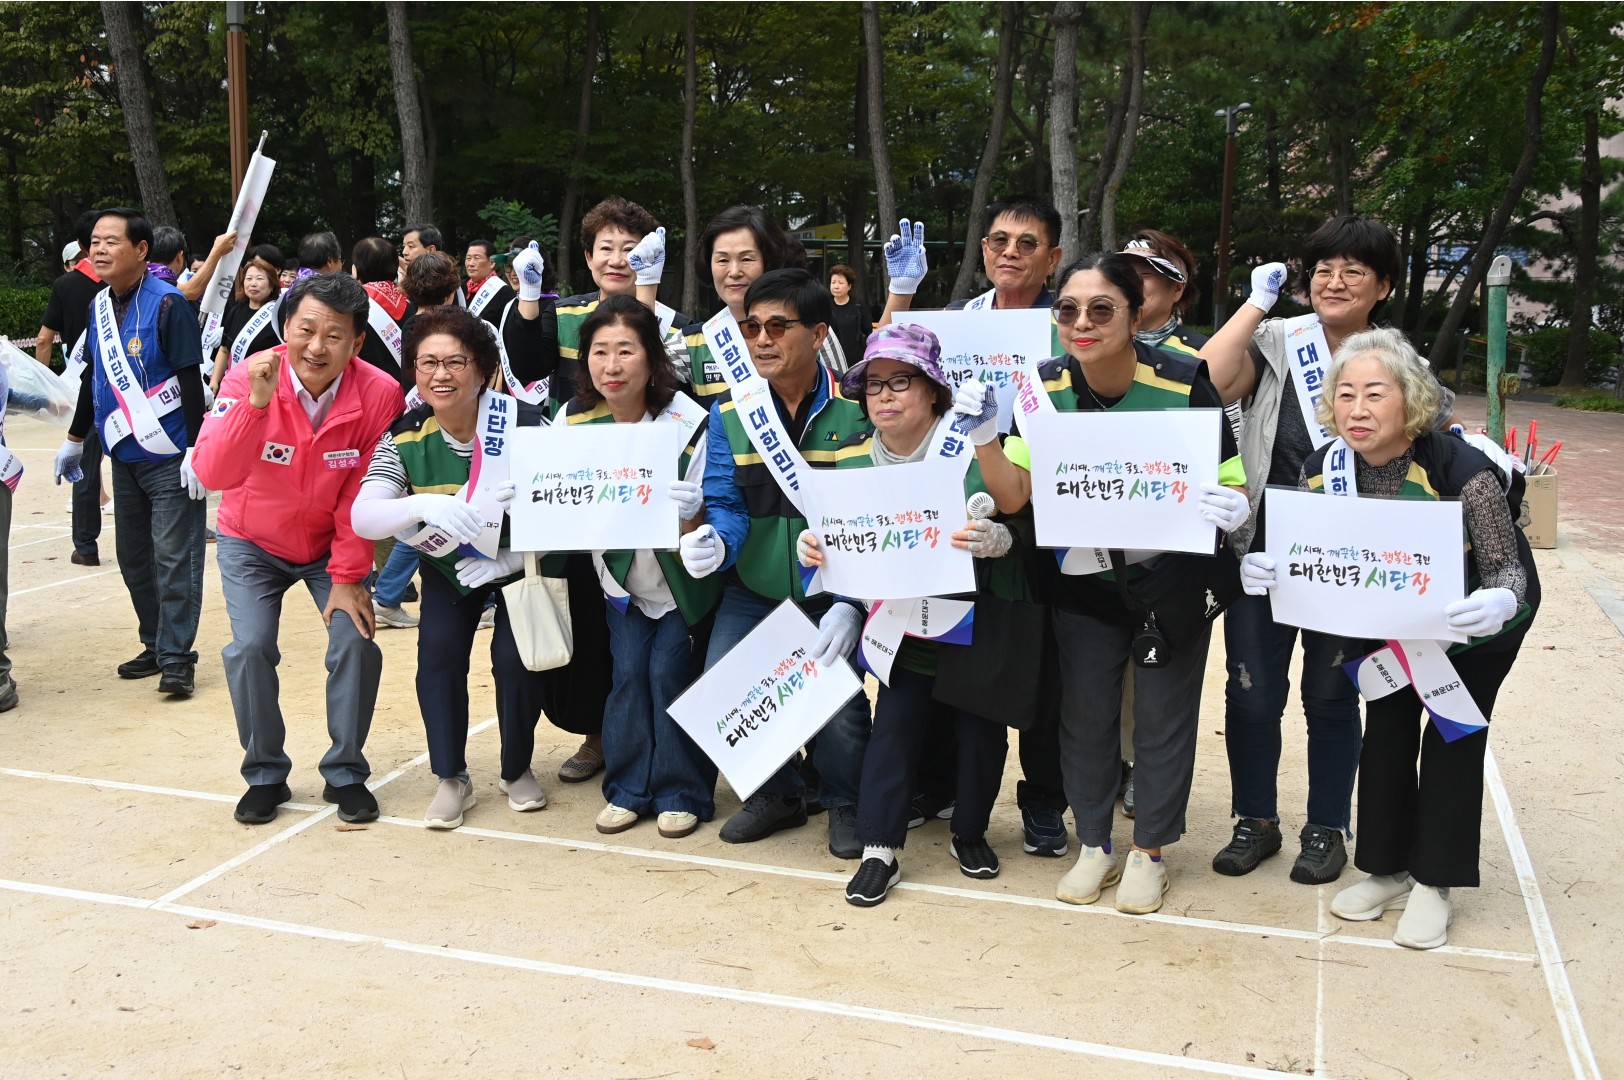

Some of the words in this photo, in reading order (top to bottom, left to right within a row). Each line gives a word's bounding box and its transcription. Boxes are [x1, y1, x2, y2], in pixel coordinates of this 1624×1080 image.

[107, 345, 131, 392] 새단장
[1012, 354, 1026, 365] 국민
[979, 369, 1025, 390] 새단장
[484, 397, 507, 457] 새단장
[328, 458, 358, 469] 김성수
[1056, 462, 1068, 475] 새
[1143, 461, 1171, 475] 행복한
[1172, 462, 1188, 475] 국민
[532, 472, 543, 484] 새
[612, 467, 638, 480] 행복한
[639, 468, 653, 479] 국민
[532, 482, 594, 505] 대한민국
[597, 483, 652, 505] 새단장
[1056, 474, 1124, 501] 대한민국
[1128, 478, 1188, 503] 새단장
[822, 515, 829, 528] 새
[895, 511, 923, 524] 행복한
[923, 509, 939, 520] 국민
[824, 528, 877, 553] 대한민국
[881, 527, 941, 552] 새단장
[1289, 542, 1301, 556] 새
[1381, 550, 1412, 565] 행복한
[1413, 553, 1430, 565] 국민
[1289, 557, 1360, 587] 대한민국
[1364, 566, 1430, 596] 새단장
[871, 638, 894, 656] 해운대구
[1376, 663, 1398, 689] 해운대구
[716, 719, 727, 734] 새
[773, 657, 797, 676] 행복한
[791, 647, 806, 660] 국민
[1431, 680, 1461, 698] 해운대구
[726, 695, 777, 748] 대한민국
[777, 659, 818, 706] 새단장
